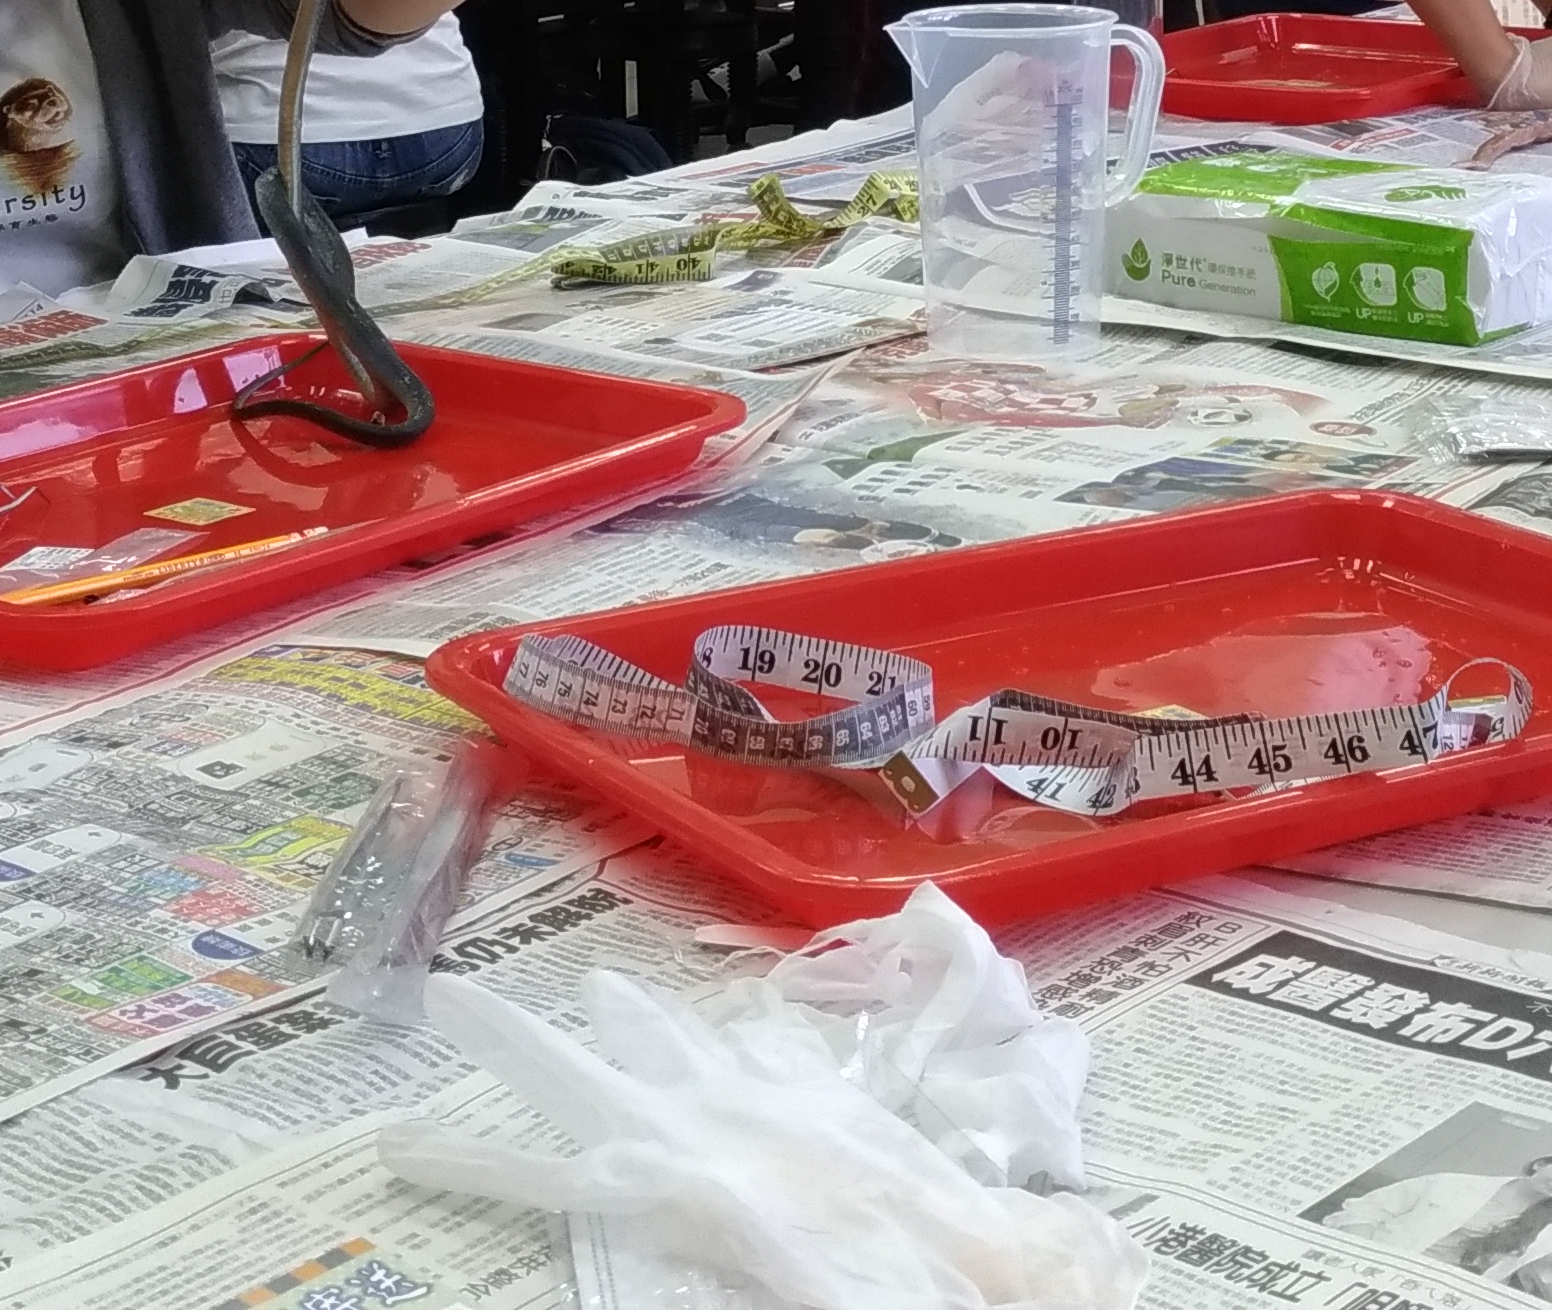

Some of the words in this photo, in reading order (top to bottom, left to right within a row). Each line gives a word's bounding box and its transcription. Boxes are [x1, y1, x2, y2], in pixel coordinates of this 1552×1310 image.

[857, 193, 878, 217] 27
[634, 261, 659, 277] 41
[676, 257, 702, 273] 40
[1161, 270, 1196, 288] Pure
[1199, 278, 1256, 296] Generation
[1356, 307, 1372, 320] UP
[1408, 311, 1424, 324] UP
[737, 645, 776, 675] 19
[535, 670, 549, 690] 76
[803, 658, 843, 689] 20
[558, 679, 573, 699] 75
[583, 688, 599, 709] 74
[611, 696, 628, 715] 73
[640, 704, 656, 720] 72
[668, 707, 684, 724] 71
[906, 698, 918, 717] 60
[859, 721, 873, 741] 64
[968, 715, 1009, 747] 11
[1040, 726, 1084, 751] 10
[1399, 721, 1441, 756] 47
[1248, 743, 1293, 776] 45
[1323, 735, 1371, 766] 46
[1170, 754, 1220, 787] 44
[1025, 776, 1065, 803] 41
[1085, 782, 1117, 810] 42
[1126, 1215, 1334, 1305] 小港醫院成立
